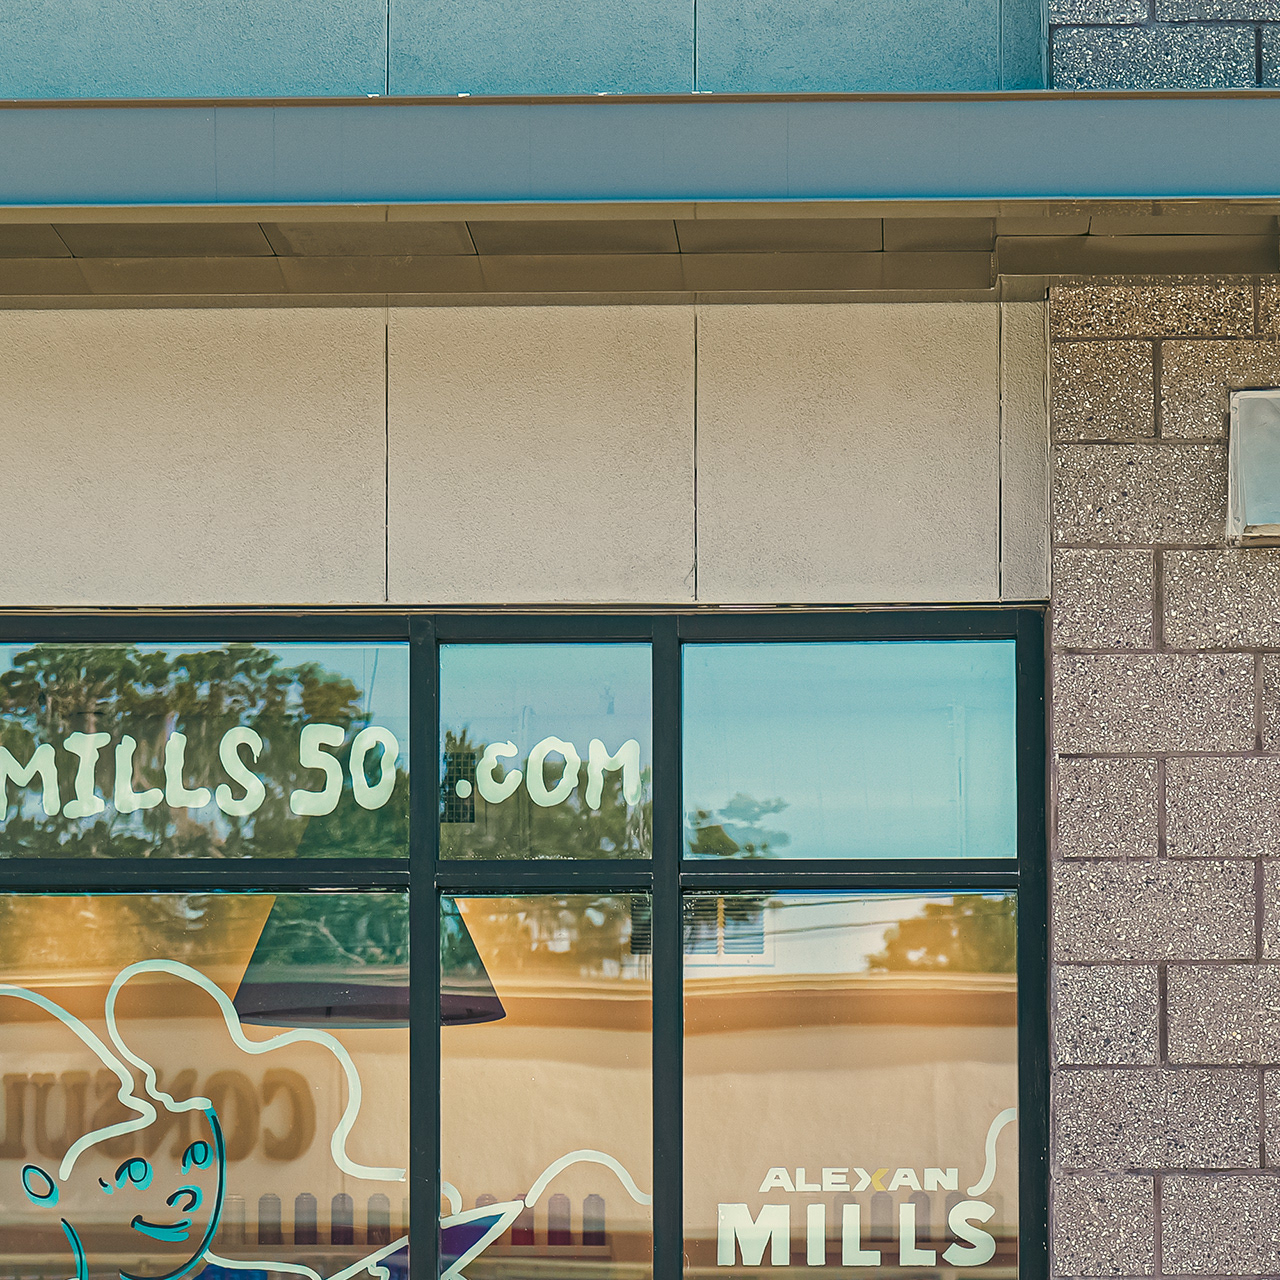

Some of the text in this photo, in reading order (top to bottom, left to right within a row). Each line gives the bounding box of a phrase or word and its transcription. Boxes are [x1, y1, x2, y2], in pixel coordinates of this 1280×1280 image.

[288, 722, 401, 818] 50
[757, 1166, 960, 1194] ALEXAN
[716, 1199, 997, 1268] MILLS
